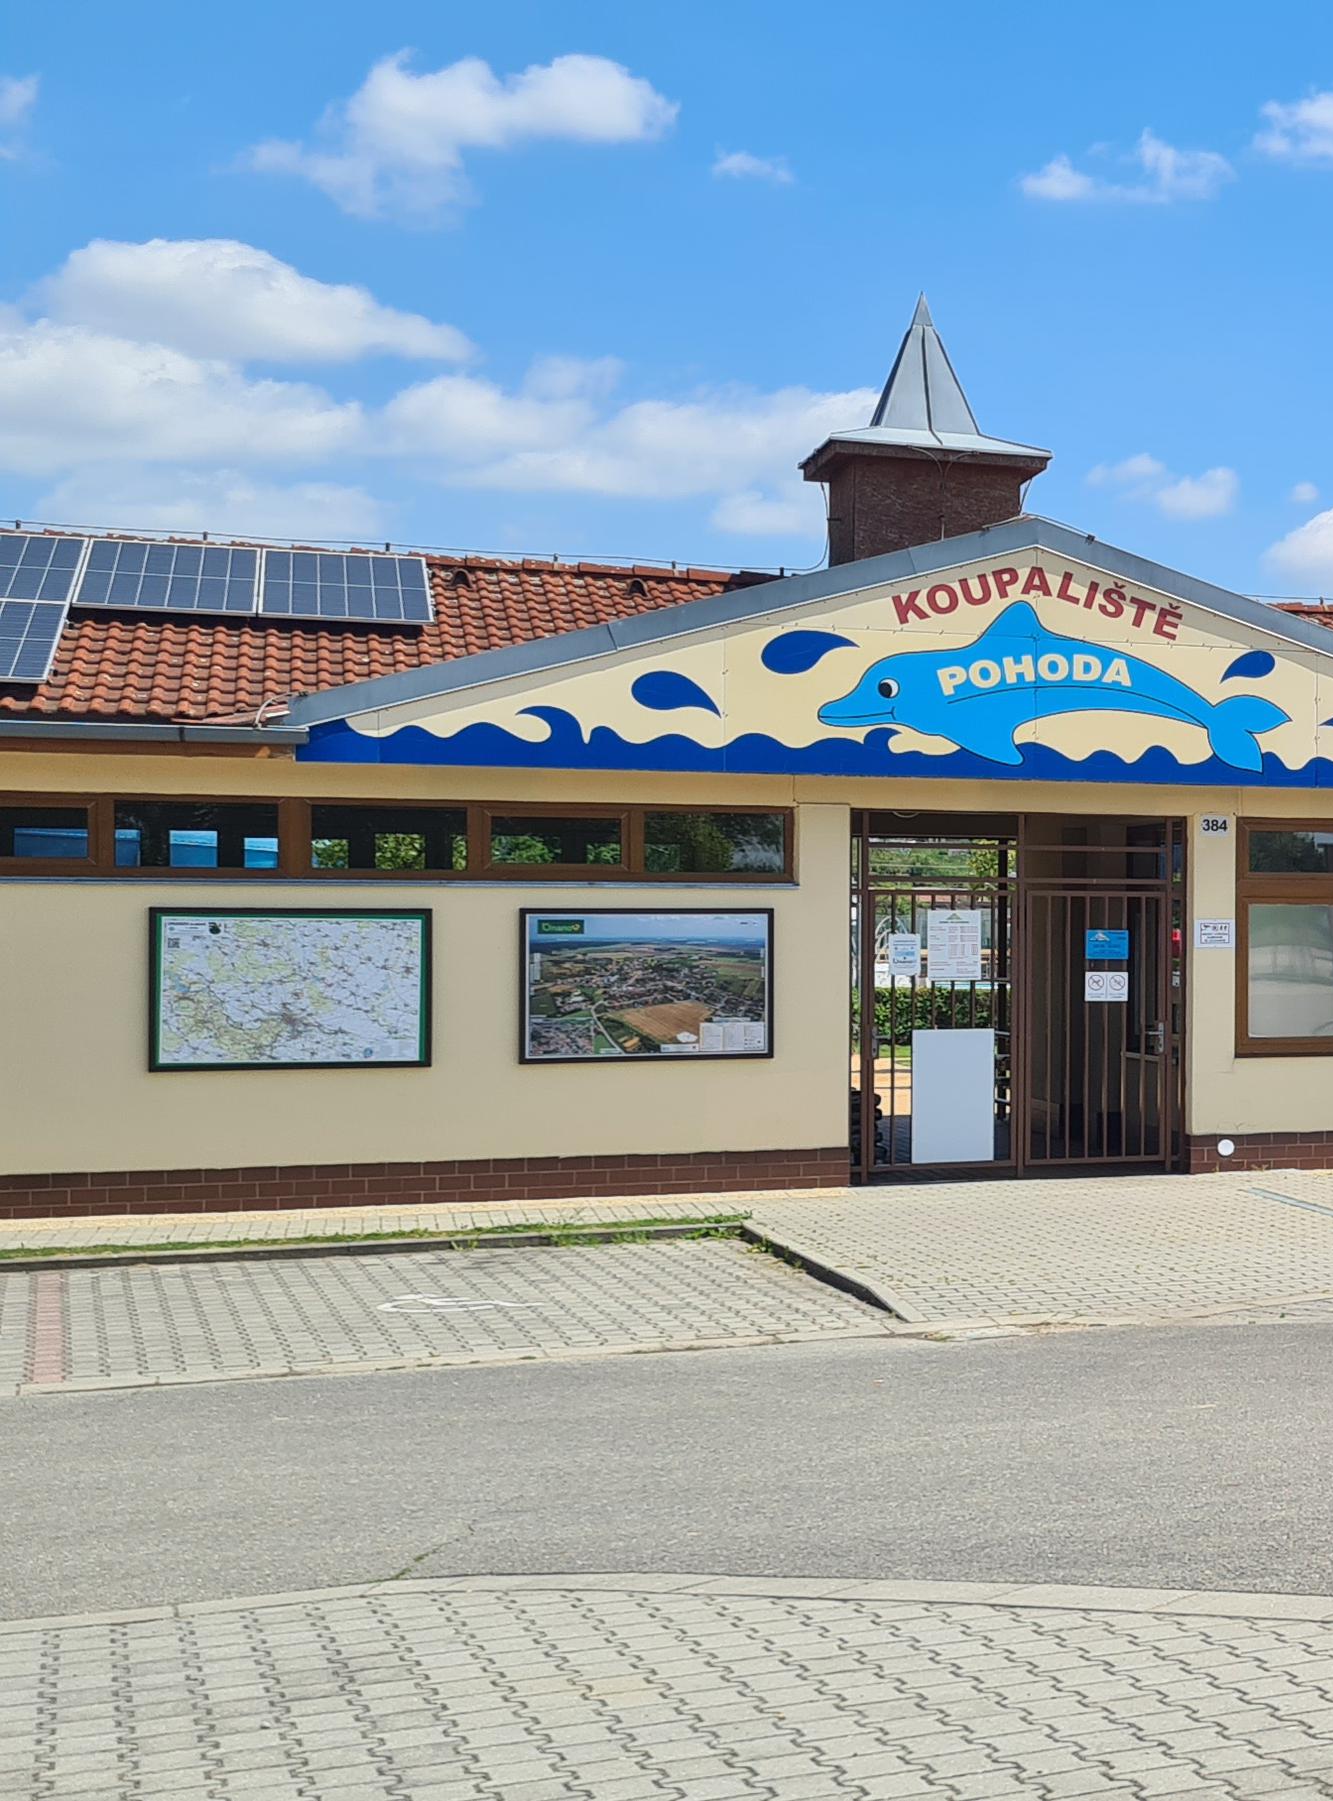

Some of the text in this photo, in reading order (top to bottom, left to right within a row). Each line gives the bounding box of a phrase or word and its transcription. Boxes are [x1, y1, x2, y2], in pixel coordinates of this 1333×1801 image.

[892, 566, 1184, 641] KOUPALIŠTĚ
[936, 654, 1132, 696] POHODA
[1202, 818, 1228, 832] 384
